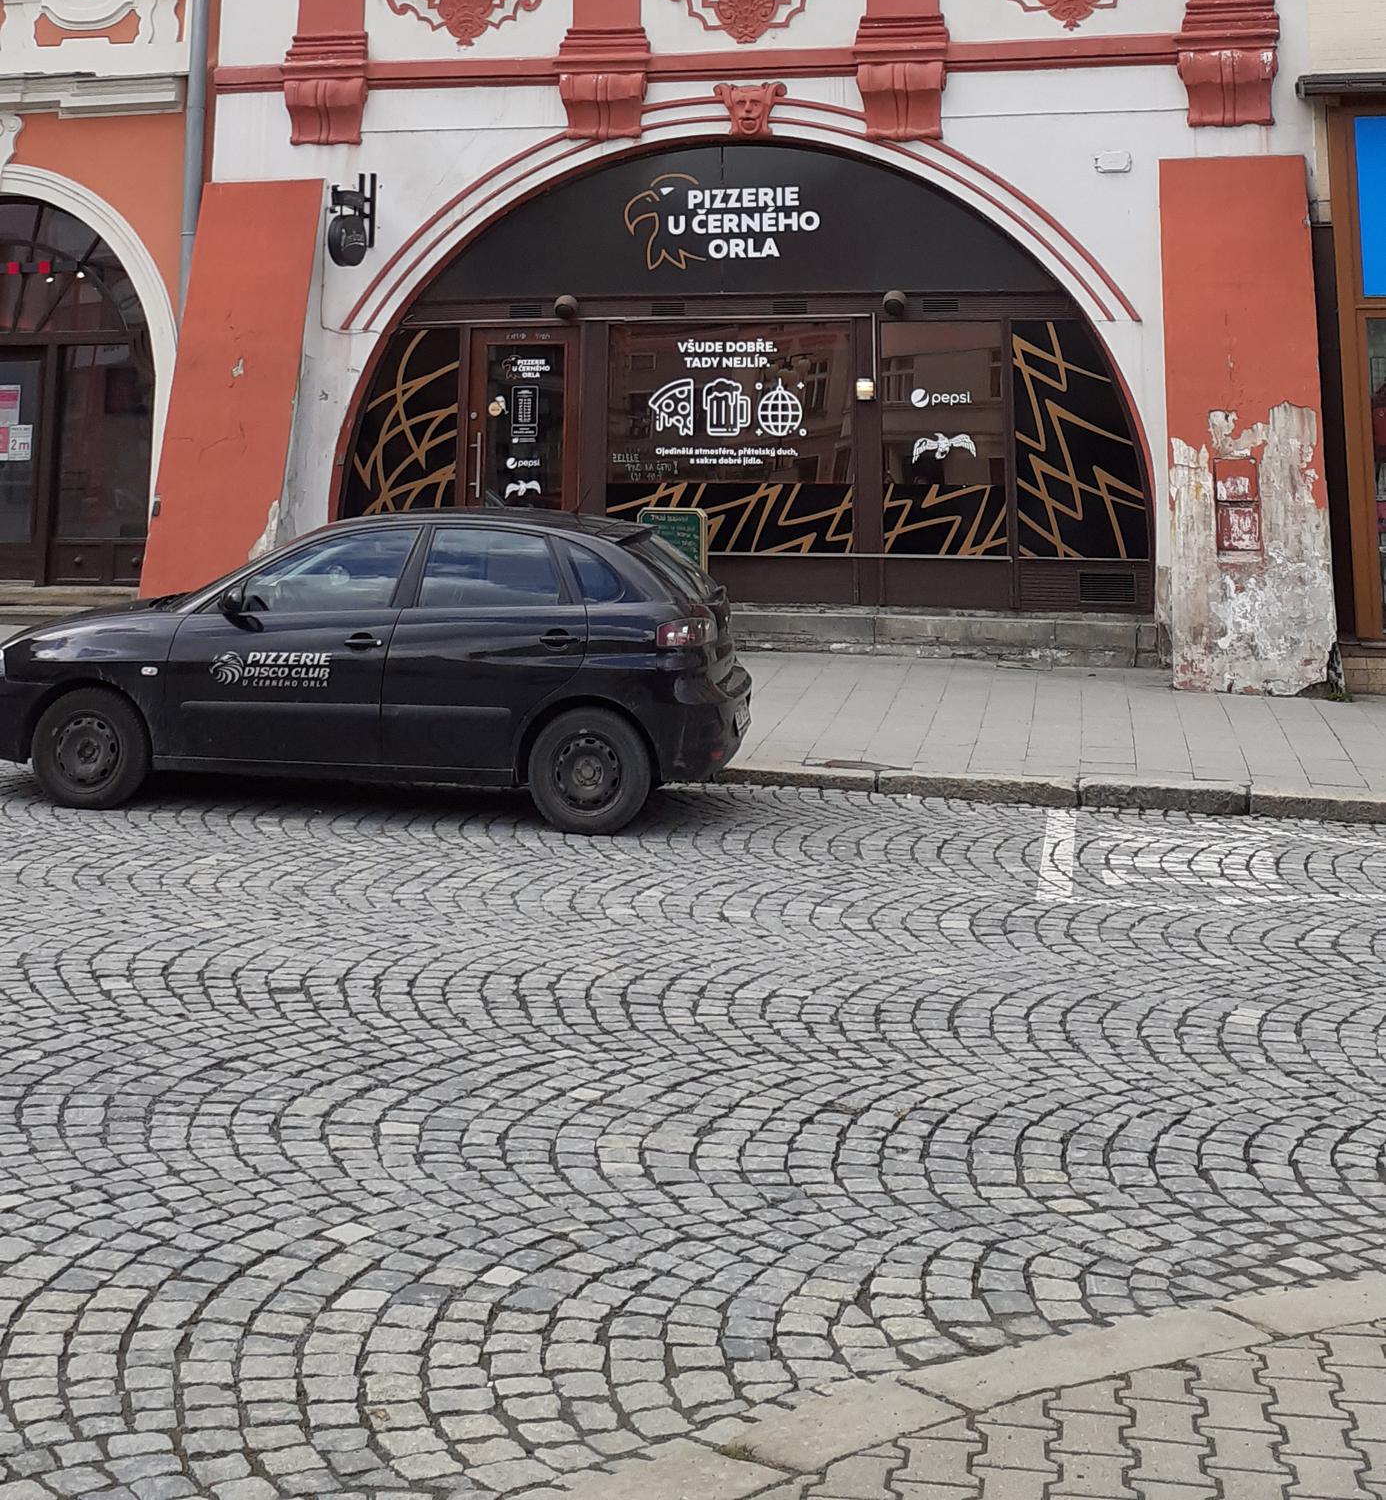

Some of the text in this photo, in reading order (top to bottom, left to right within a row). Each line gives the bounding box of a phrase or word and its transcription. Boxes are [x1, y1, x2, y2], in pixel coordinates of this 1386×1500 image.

[687, 186, 800, 209] PIZZERIE
[667, 206, 820, 235] U ČERNÉHO
[708, 237, 780, 258] ORLA
[677, 338, 778, 353] VŠUDE DOBŘE.
[518, 364, 551, 372] ČERNÉHO
[684, 353, 771, 368] TADY NEJLÍP.
[931, 391, 972, 406] pepsi
[776, 447, 799, 457] duch,
[517, 459, 541, 469] pepsi
[246, 651, 333, 666] PIZZERIE
[243, 666, 330, 680] DISCO CLUB
[242, 678, 329, 688] U ČERNÉHO ORLA
